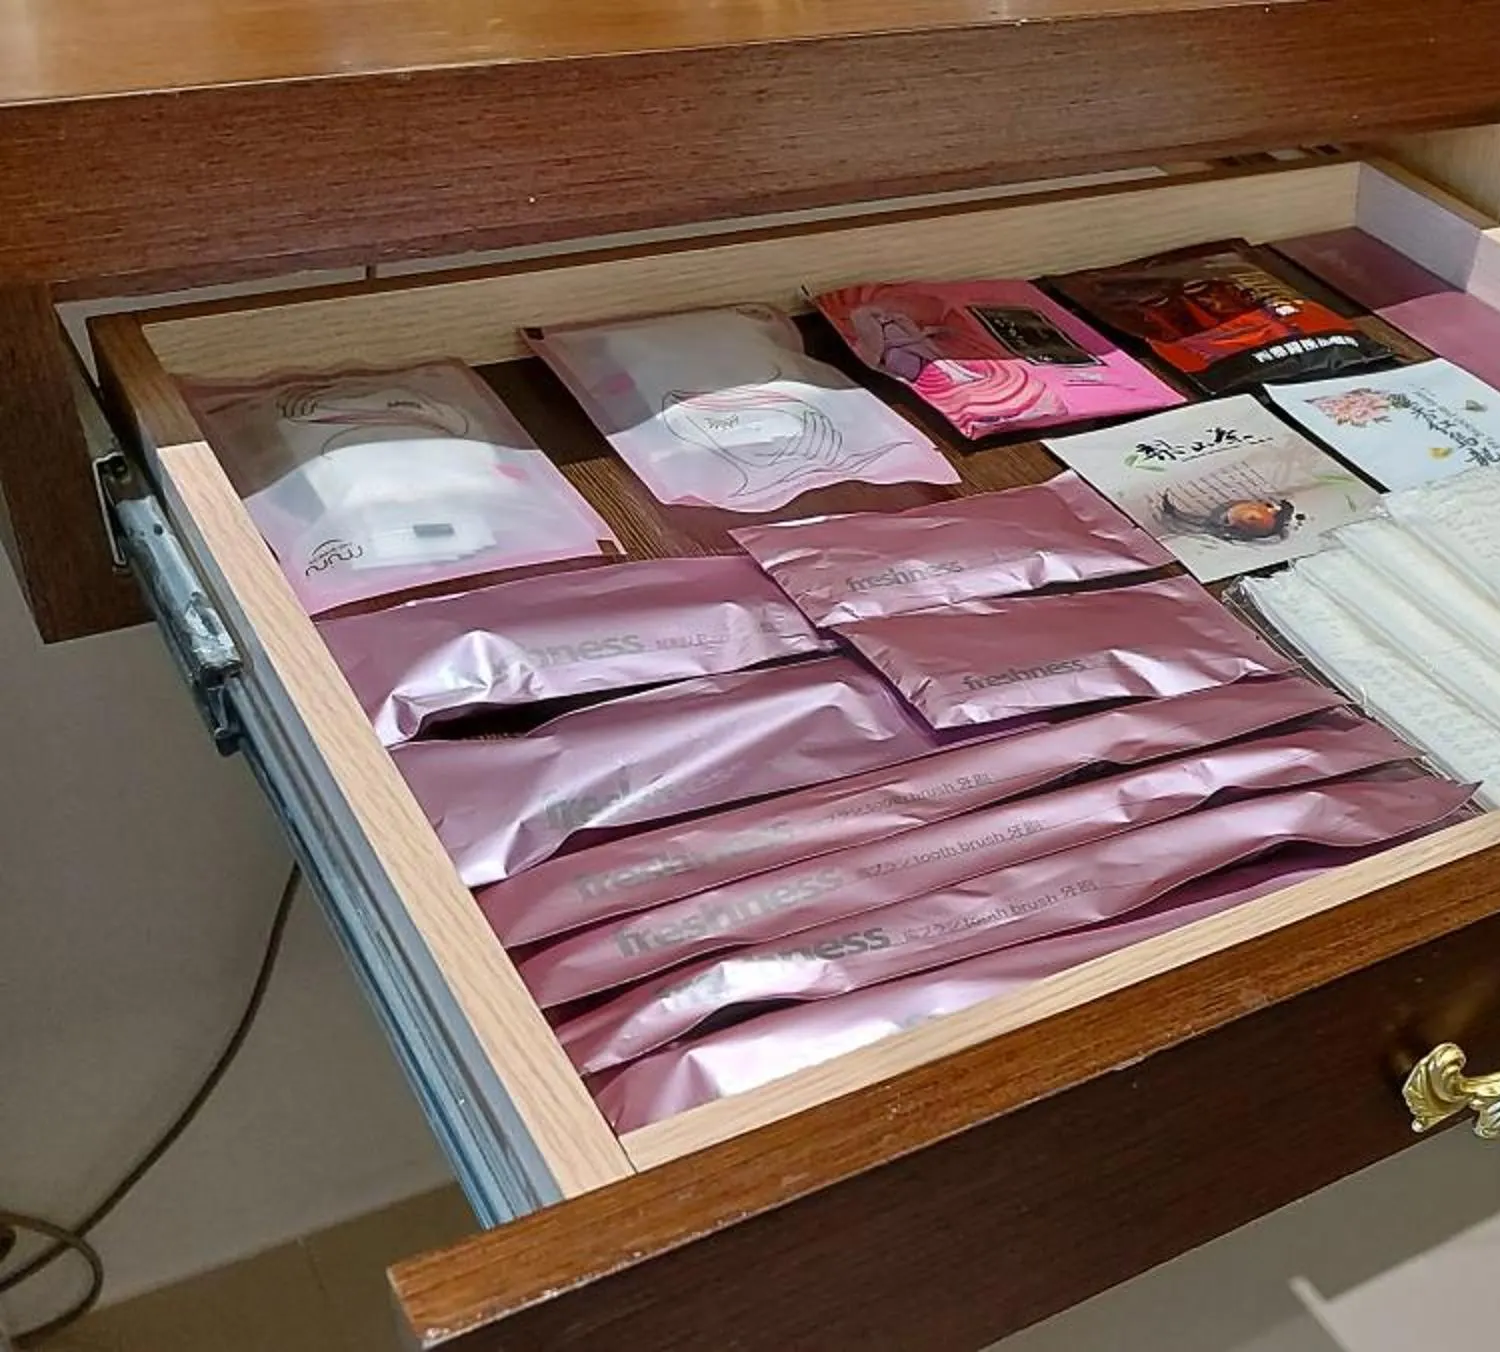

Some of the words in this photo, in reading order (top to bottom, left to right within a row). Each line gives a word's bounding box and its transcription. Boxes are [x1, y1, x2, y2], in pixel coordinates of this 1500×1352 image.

[846, 560, 964, 593] freshness
[962, 657, 1089, 692] freshness
[957, 829, 1007, 853] brush
[1008, 892, 1058, 917] brush
